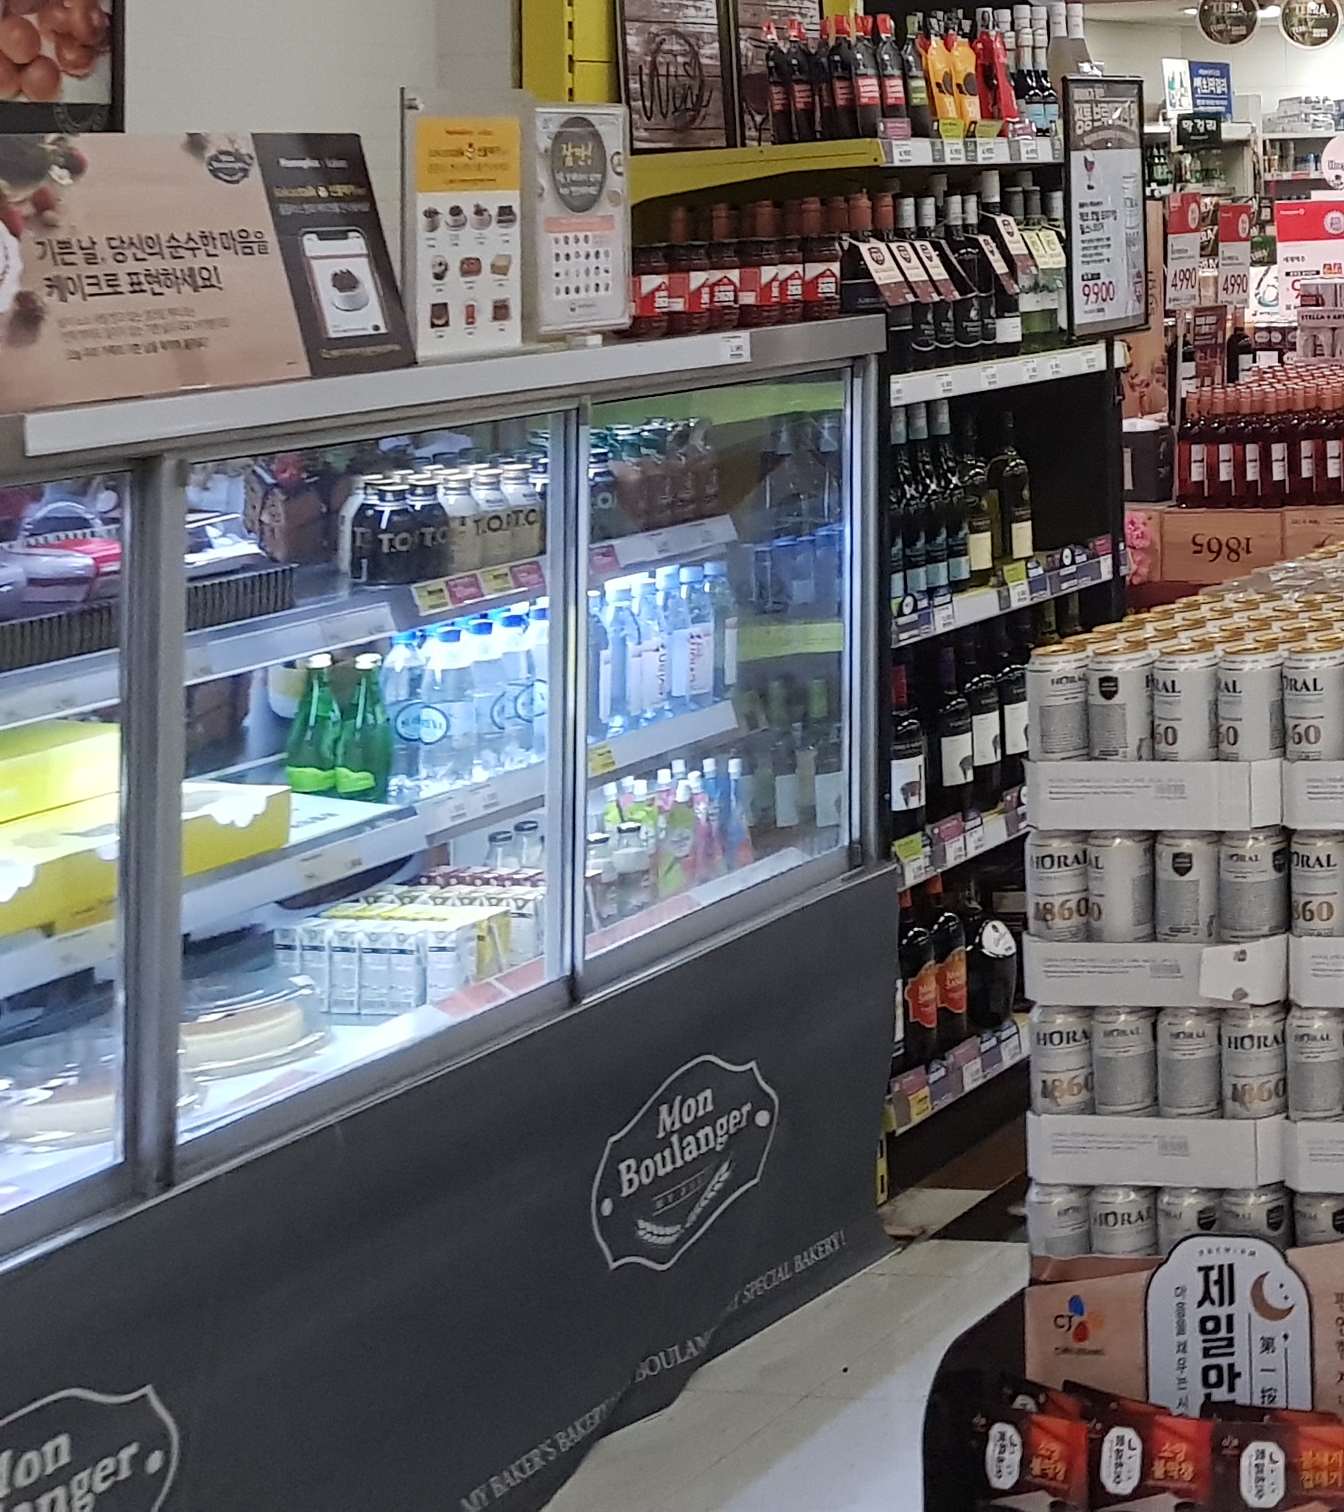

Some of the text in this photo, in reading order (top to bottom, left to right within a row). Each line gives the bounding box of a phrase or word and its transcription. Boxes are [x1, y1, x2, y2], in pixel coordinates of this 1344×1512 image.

[35, 238, 79, 266] 기쁜
[105, 232, 166, 263] 당신의
[165, 228, 220, 260] 순수한
[219, 227, 271, 256] 마음을
[43, 264, 224, 303] 케이크로 표현하세요!
[655, 1087, 715, 1140] Mon
[616, 1101, 753, 1199] Boulanger
